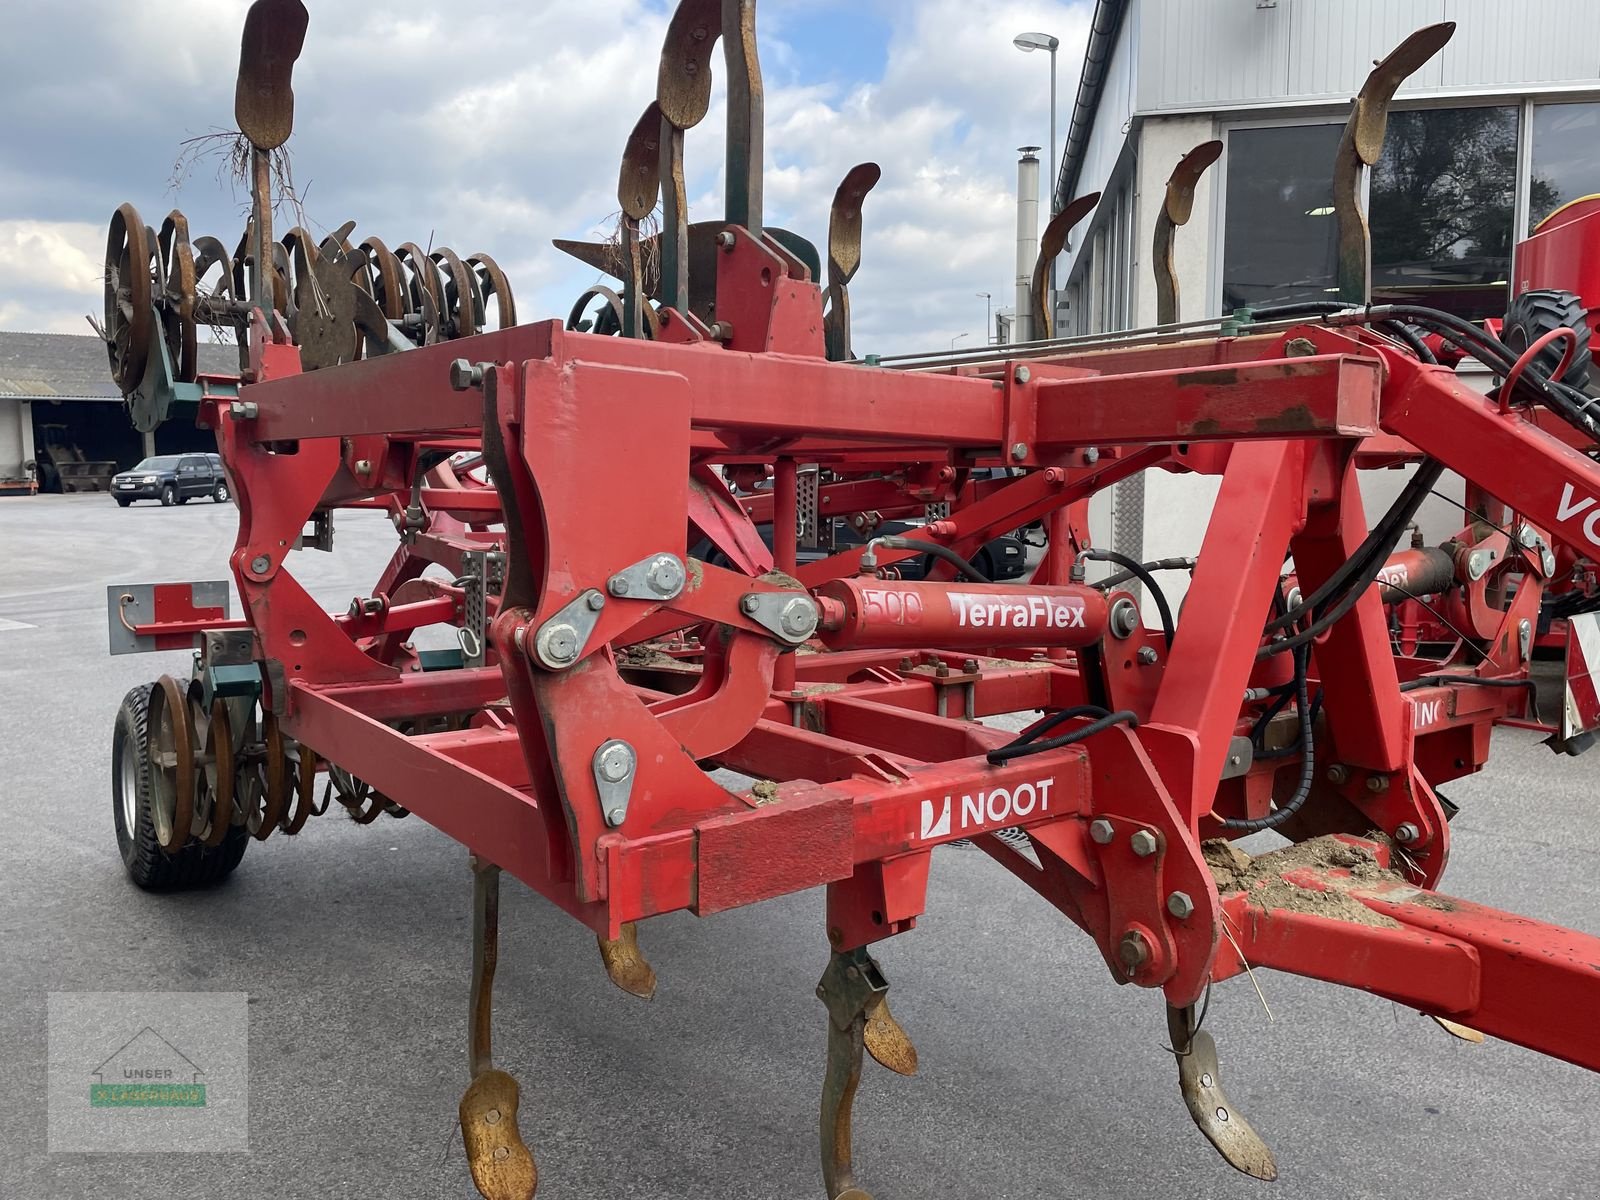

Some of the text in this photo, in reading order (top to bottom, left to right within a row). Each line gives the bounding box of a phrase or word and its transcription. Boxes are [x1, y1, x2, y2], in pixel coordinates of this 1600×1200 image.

[865, 592, 923, 623] 500
[950, 594, 1086, 628] TerraFlex
[961, 779, 1055, 828] NOOT
